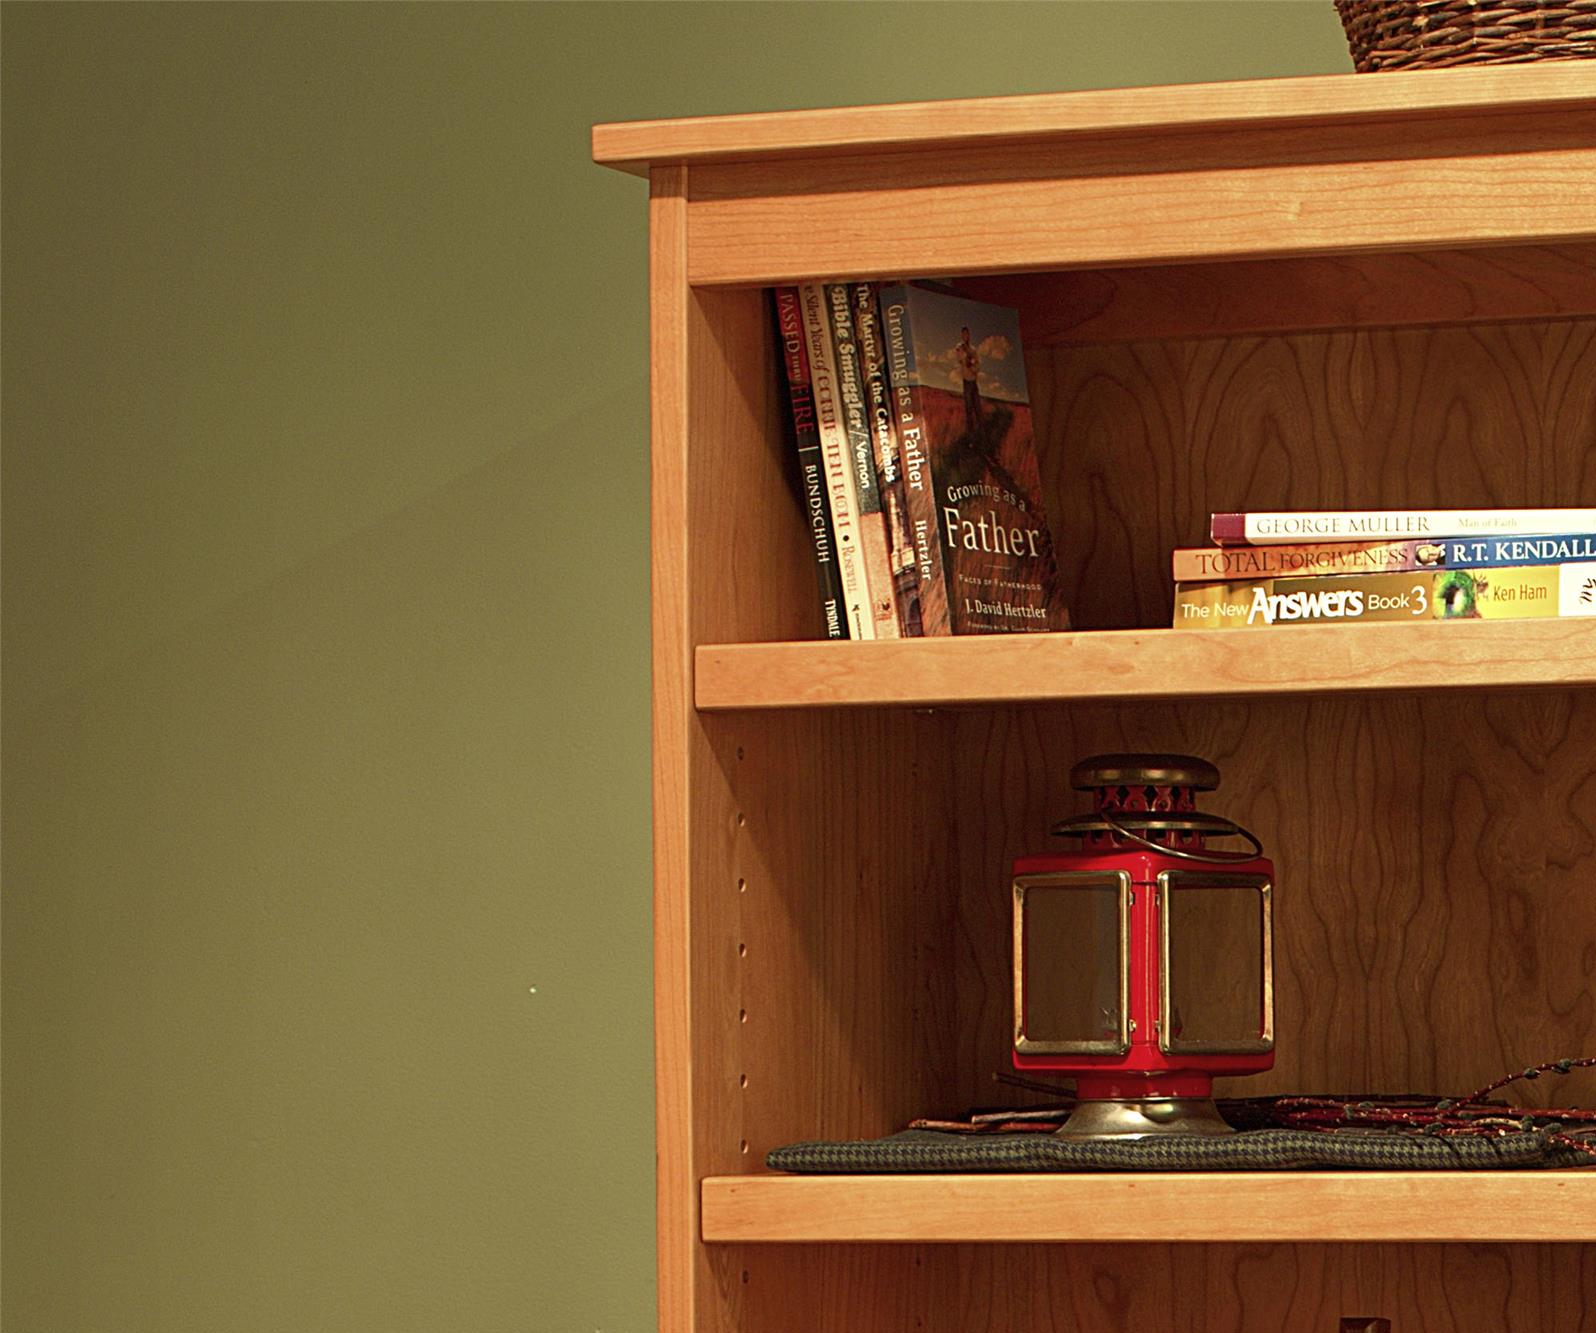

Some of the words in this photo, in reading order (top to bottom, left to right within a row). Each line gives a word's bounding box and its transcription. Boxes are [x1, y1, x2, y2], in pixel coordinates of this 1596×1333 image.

[832, 287, 850, 338] Bible
[862, 314, 876, 358] Martyr
[888, 304, 908, 381] Growing
[780, 294, 800, 352] PASSED
[791, 383, 814, 434] FIRE
[869, 363, 880, 377] of
[839, 343, 862, 429] Smuggler
[872, 382, 884, 403] the
[898, 387, 912, 406] as
[902, 412, 914, 422] a
[856, 440, 870, 489] Vernon
[875, 408, 896, 482] Catacombs
[904, 428, 925, 491] Father
[805, 464, 830, 563] BUNDSCHUH
[947, 481, 1000, 502] Growing
[1004, 490, 1016, 504] as
[1019, 500, 1026, 512] a
[943, 507, 1040, 558] Father
[1256, 518, 1340, 534] GEORGE
[1348, 516, 1430, 533] MULLER
[1458, 518, 1477, 528] Man
[1494, 517, 1518, 528] Faith
[914, 520, 932, 580] Hertzler
[1195, 552, 1276, 574] TOTAL
[1280, 548, 1408, 570] FORGIVENESS
[1452, 543, 1488, 562] R.T.
[976, 600, 1002, 616] David
[1004, 603, 1047, 618] Hertzler
[1182, 603, 1210, 618] The
[1214, 602, 1249, 618] New
[1247, 587, 1364, 624] Answers
[1368, 593, 1410, 610] Book
[1411, 585, 1428, 616] 3
[1493, 586, 1516, 601] Ken
[1520, 584, 1547, 600] Ham
[825, 599, 840, 638] TYNDALE
